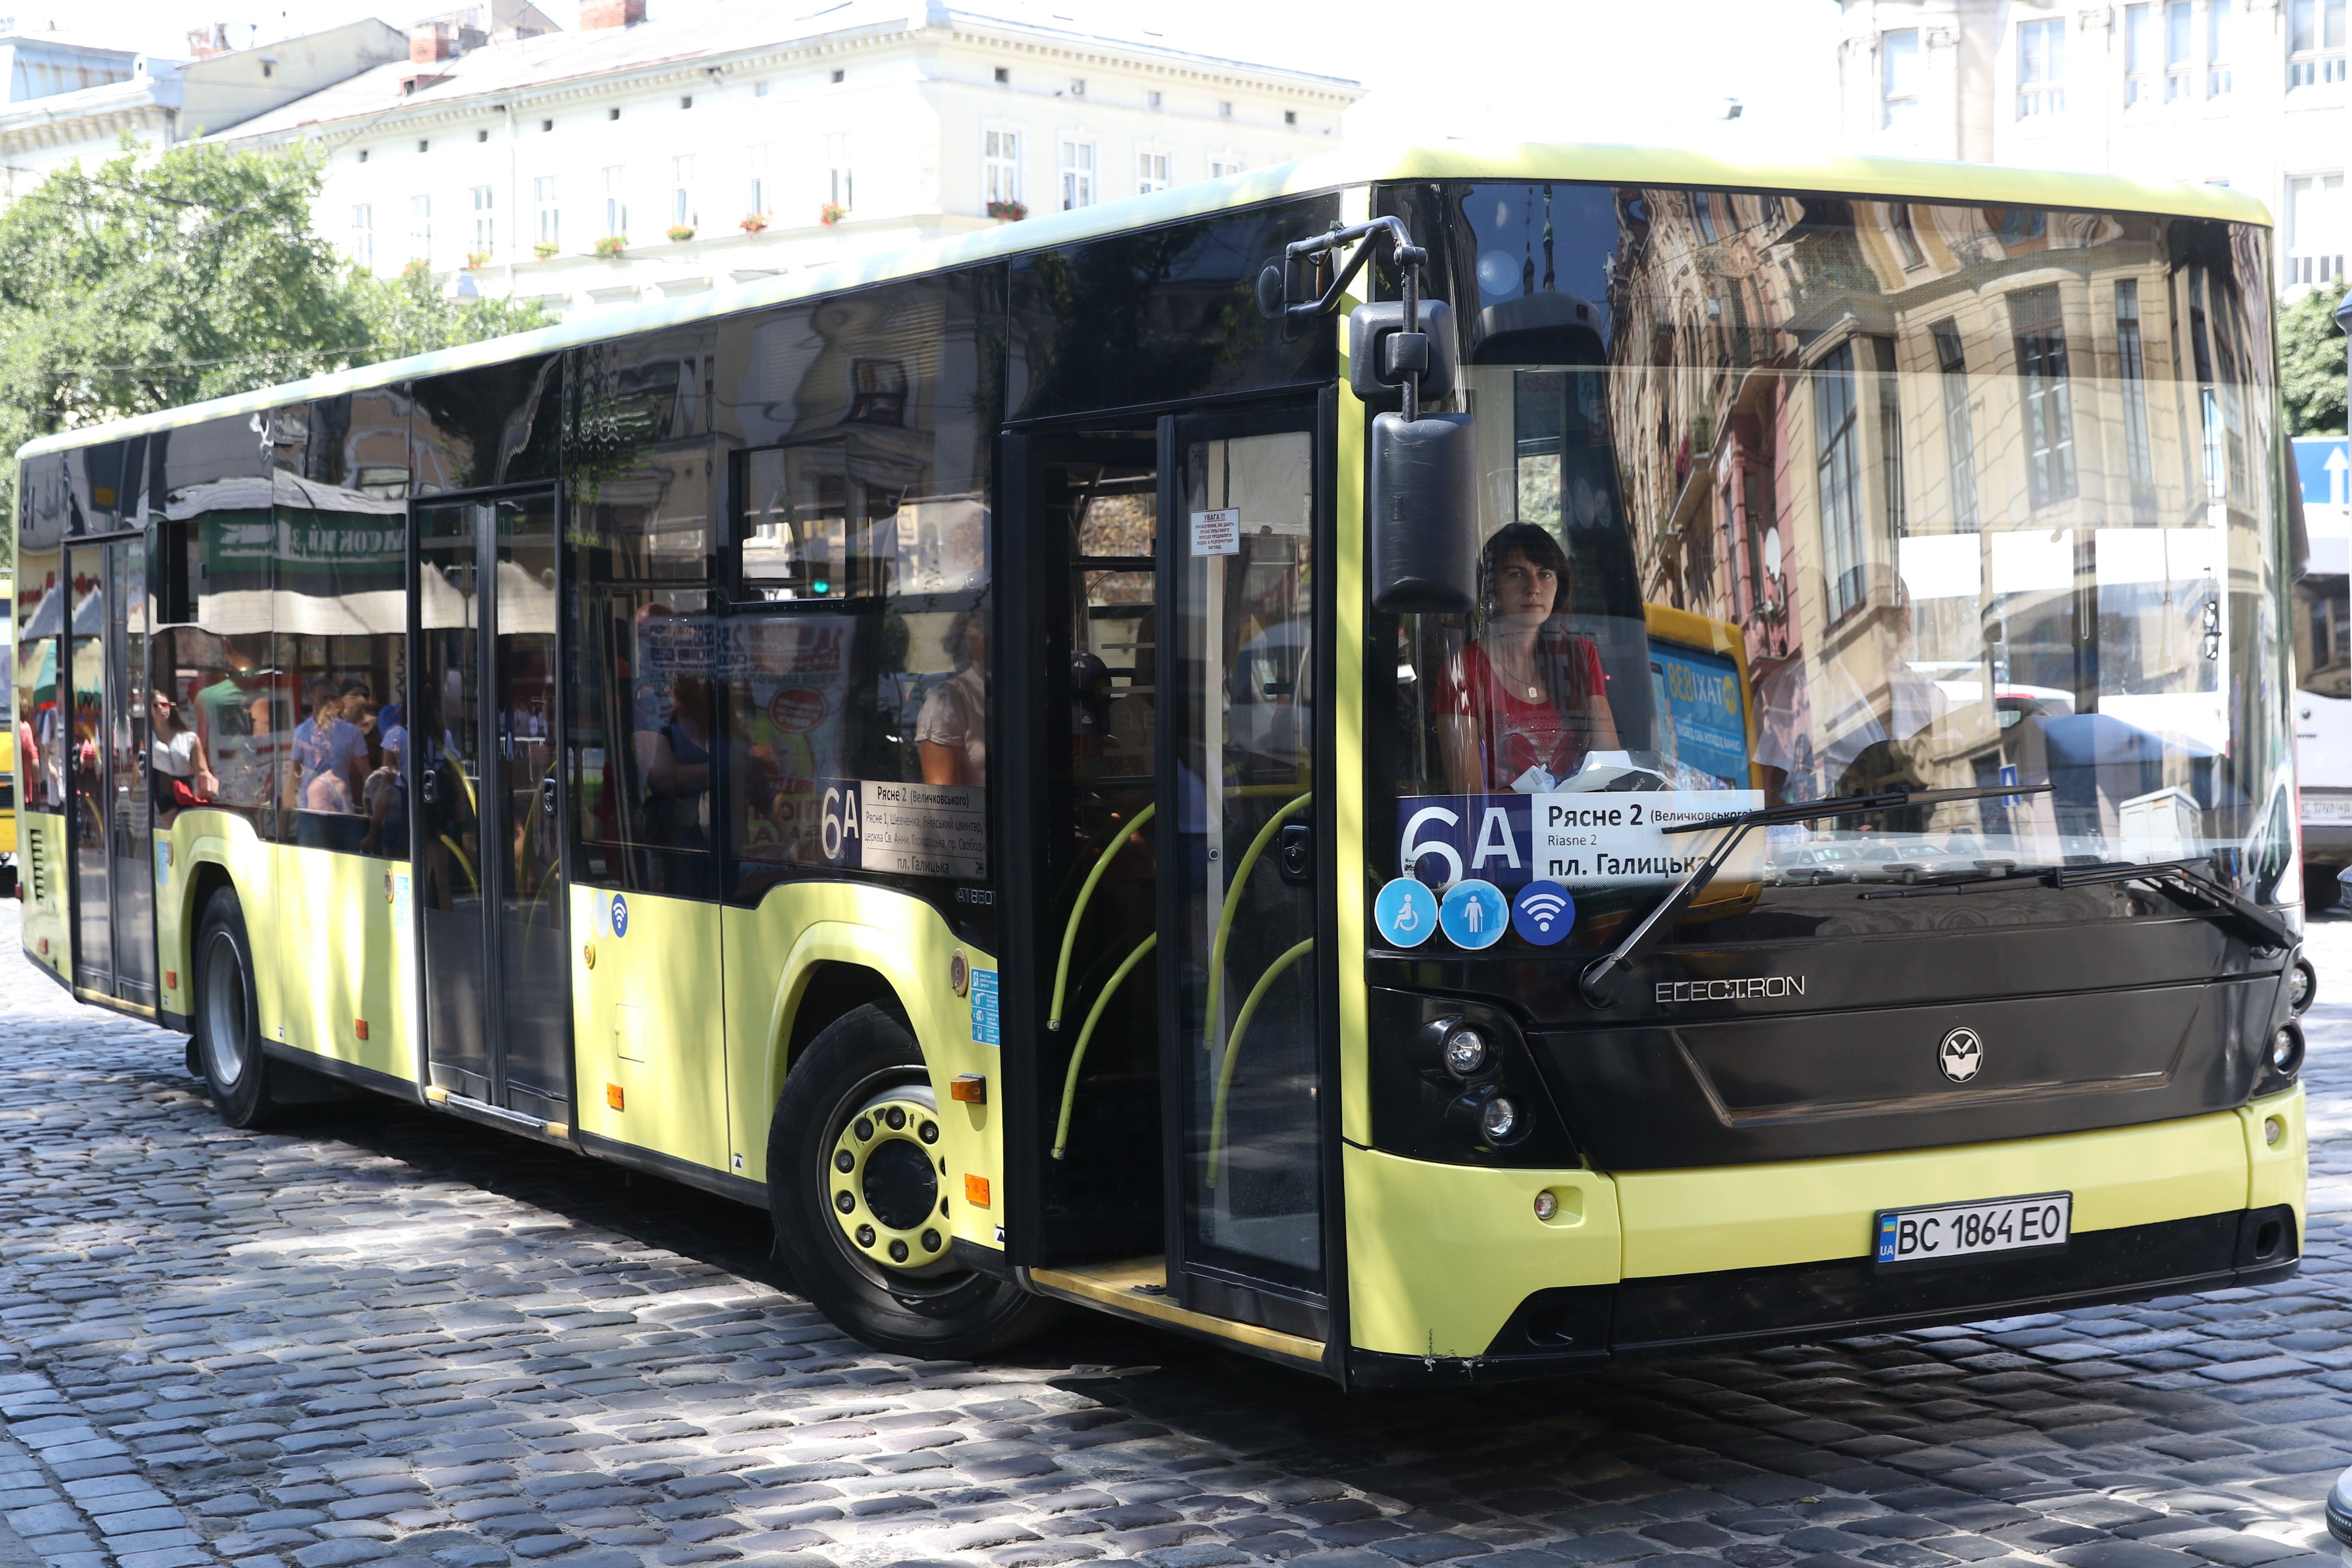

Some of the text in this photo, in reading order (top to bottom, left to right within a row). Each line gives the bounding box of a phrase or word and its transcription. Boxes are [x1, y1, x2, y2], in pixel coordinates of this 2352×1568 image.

[877, 786, 969, 809] Рясне 2 (Величковського)
[866, 811, 983, 835] Рясне 1, Шевченка, Янівський цвинтар,
[1548, 805, 1622, 829] Рясне
[1630, 804, 1643, 827] 2
[864, 832, 986, 853] церква Св. Анни, Городоцька, пр. Свободи
[1548, 833, 1597, 847] Riasne 2
[897, 856, 949, 876] пл. Галицька
[1549, 859, 1587, 876] пл.
[1656, 975, 1805, 1003] ELECTRON
[1898, 1205, 2060, 1255] BC 1864 EO
[1880, 1244, 1894, 1256] UA
